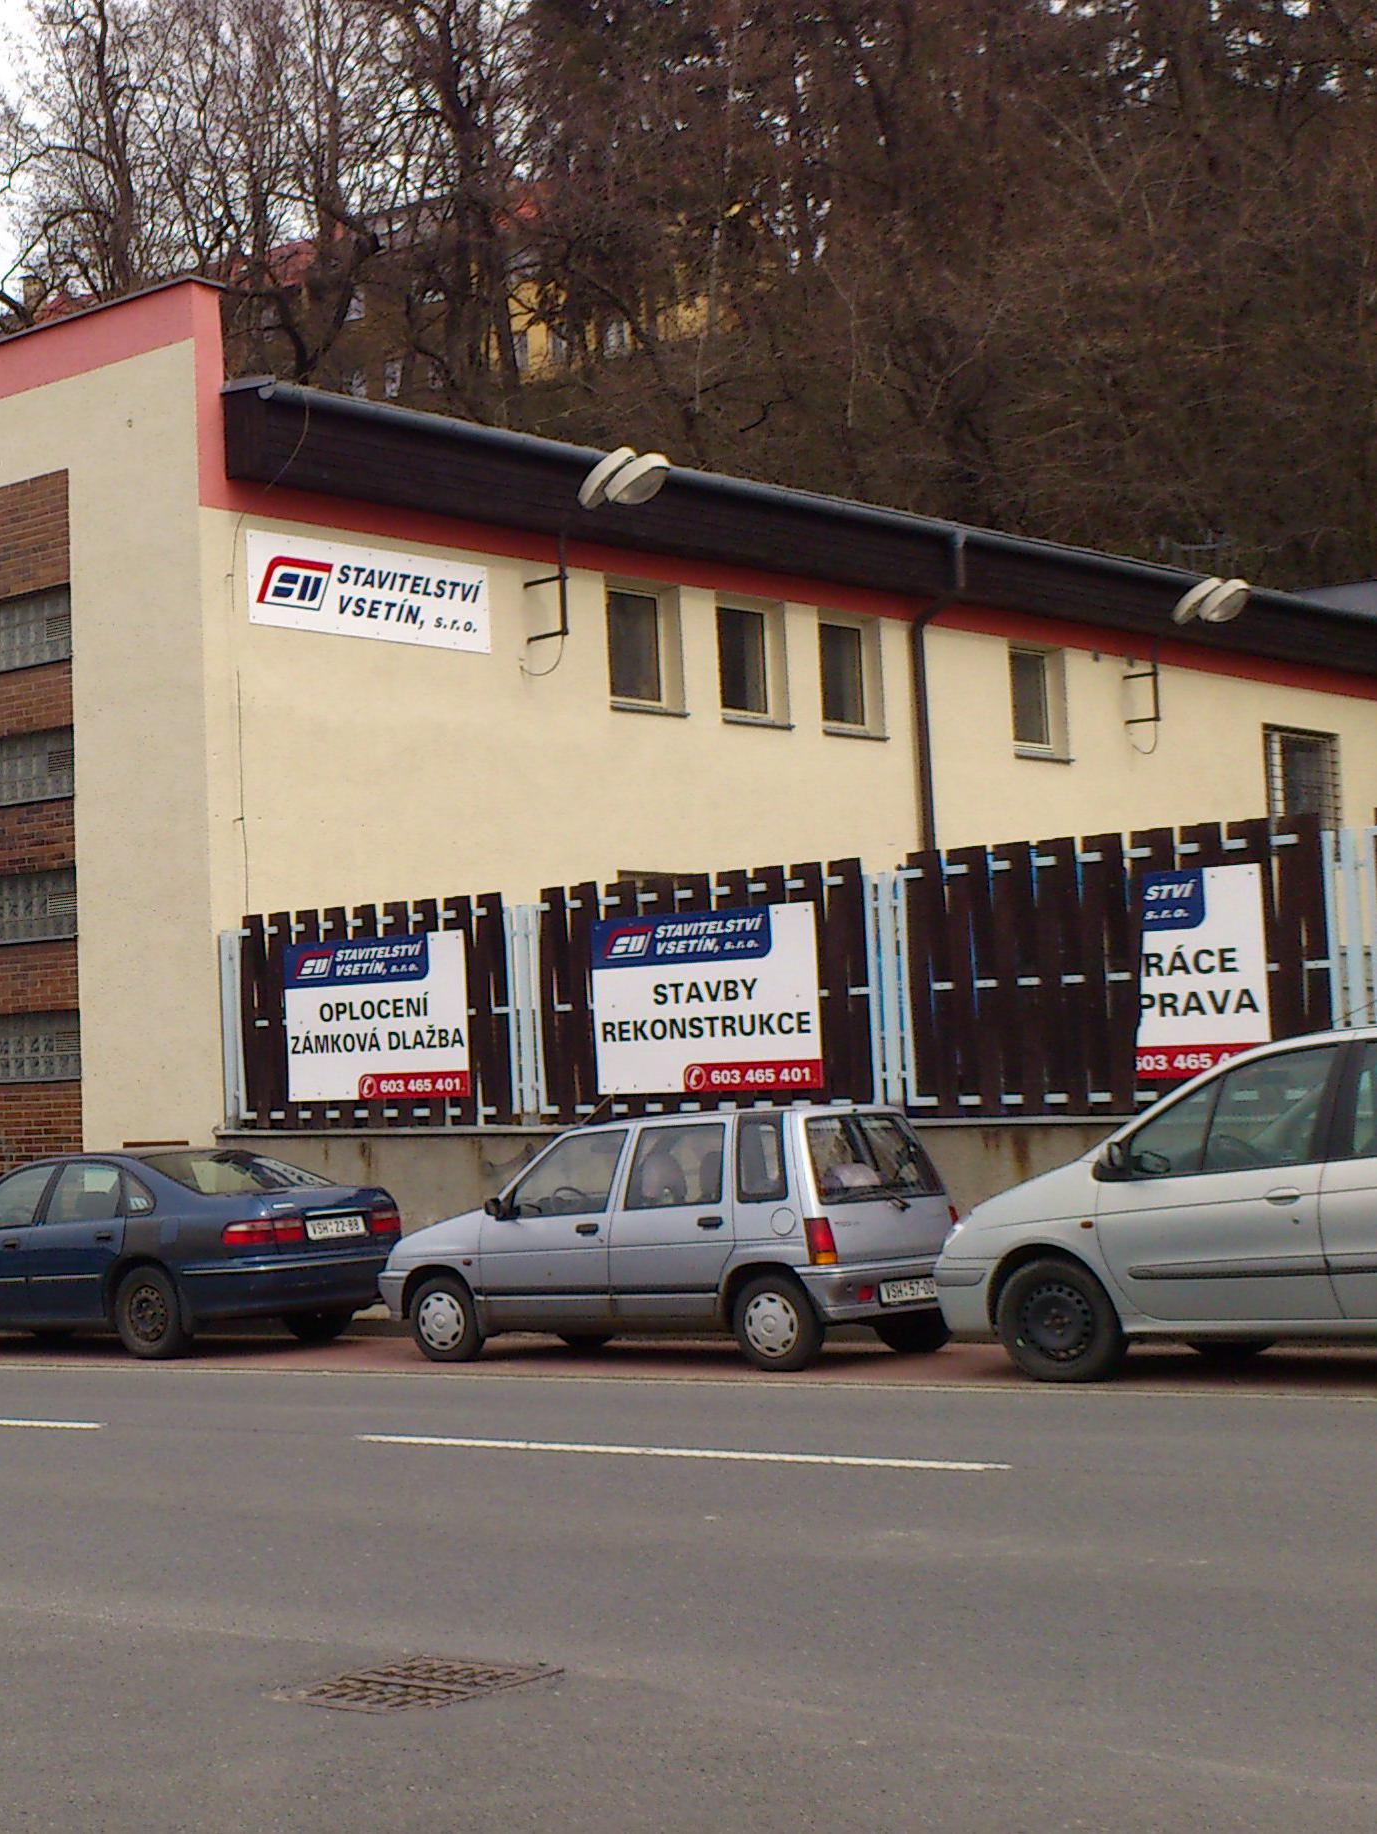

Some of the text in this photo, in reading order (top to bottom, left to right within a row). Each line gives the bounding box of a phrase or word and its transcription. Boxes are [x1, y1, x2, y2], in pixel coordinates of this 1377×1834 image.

[336, 565, 484, 603] STAVITELSTVÍ
[338, 595, 478, 633] VSETÍN, s.r.o.
[655, 913, 764, 938] STAVITELSTVÍ
[335, 940, 424, 962] STAVITELSTVÍ
[656, 936, 759, 955] VSETÍN, s.r.o.
[335, 960, 419, 977] VSETÍN, s.r.o.
[1143, 944, 1240, 977] RÁCE
[653, 977, 758, 1006] STAVBY
[319, 991, 430, 1023] OPLOCENÍ
[290, 1024, 465, 1055] ZÁMKOVÁ DLAŽBA
[601, 1011, 812, 1043] REKONSTRUKCE
[1172, 1052, 1213, 1070] 465
[379, 1077, 462, 1094] 603 465 401
[710, 1066, 811, 1084] 603 465 401
